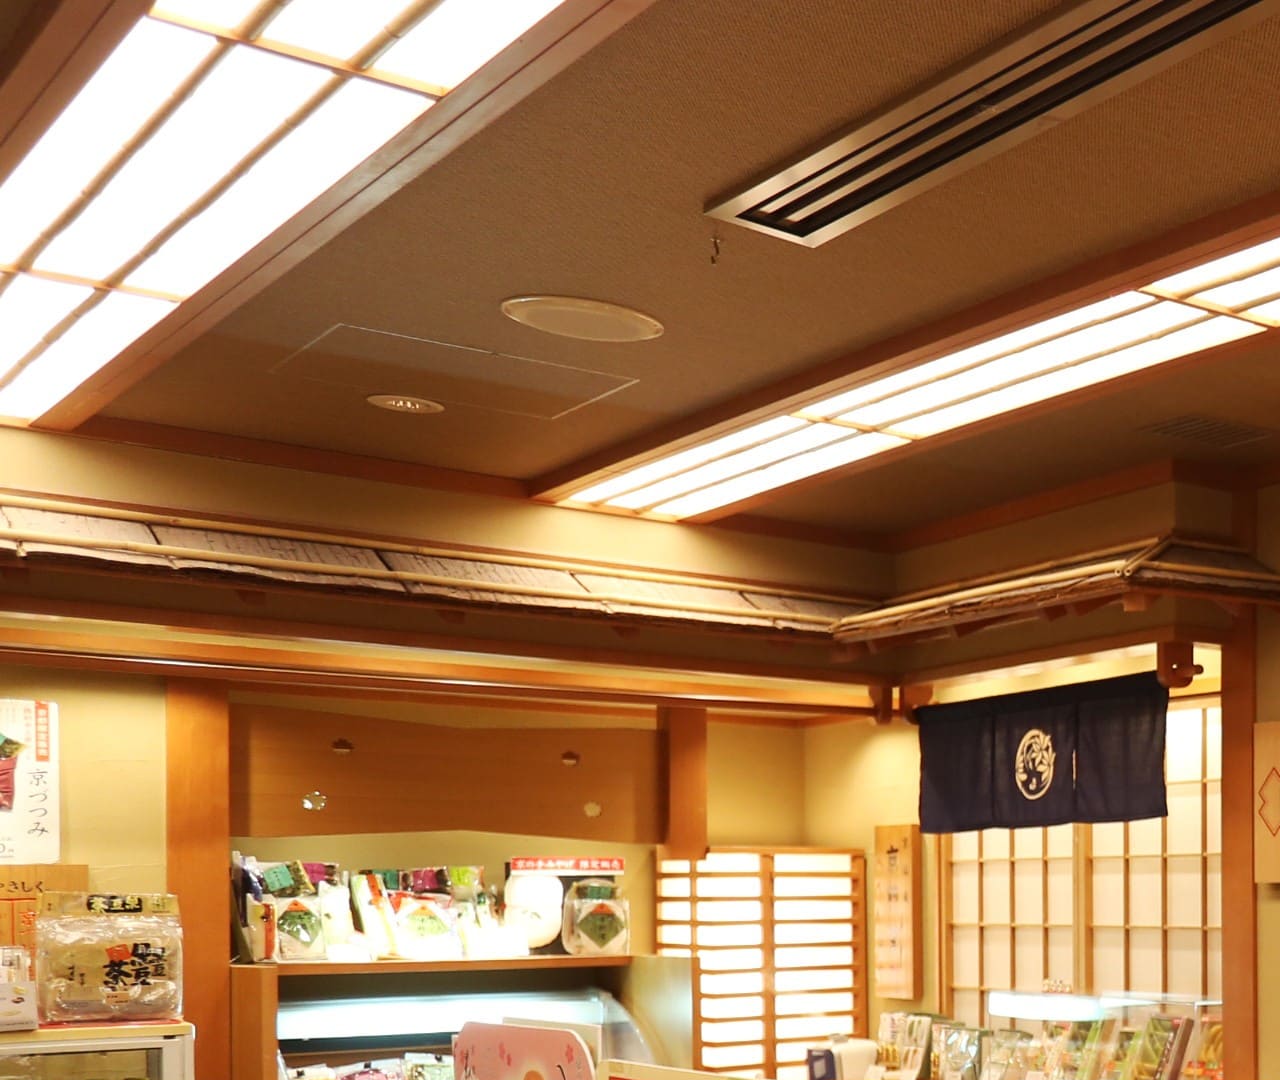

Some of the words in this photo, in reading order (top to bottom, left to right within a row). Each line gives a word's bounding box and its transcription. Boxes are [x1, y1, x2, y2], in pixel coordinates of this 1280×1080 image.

[27, 768, 49, 837] 京づつみ
[0, 880, 45, 894] さしく
